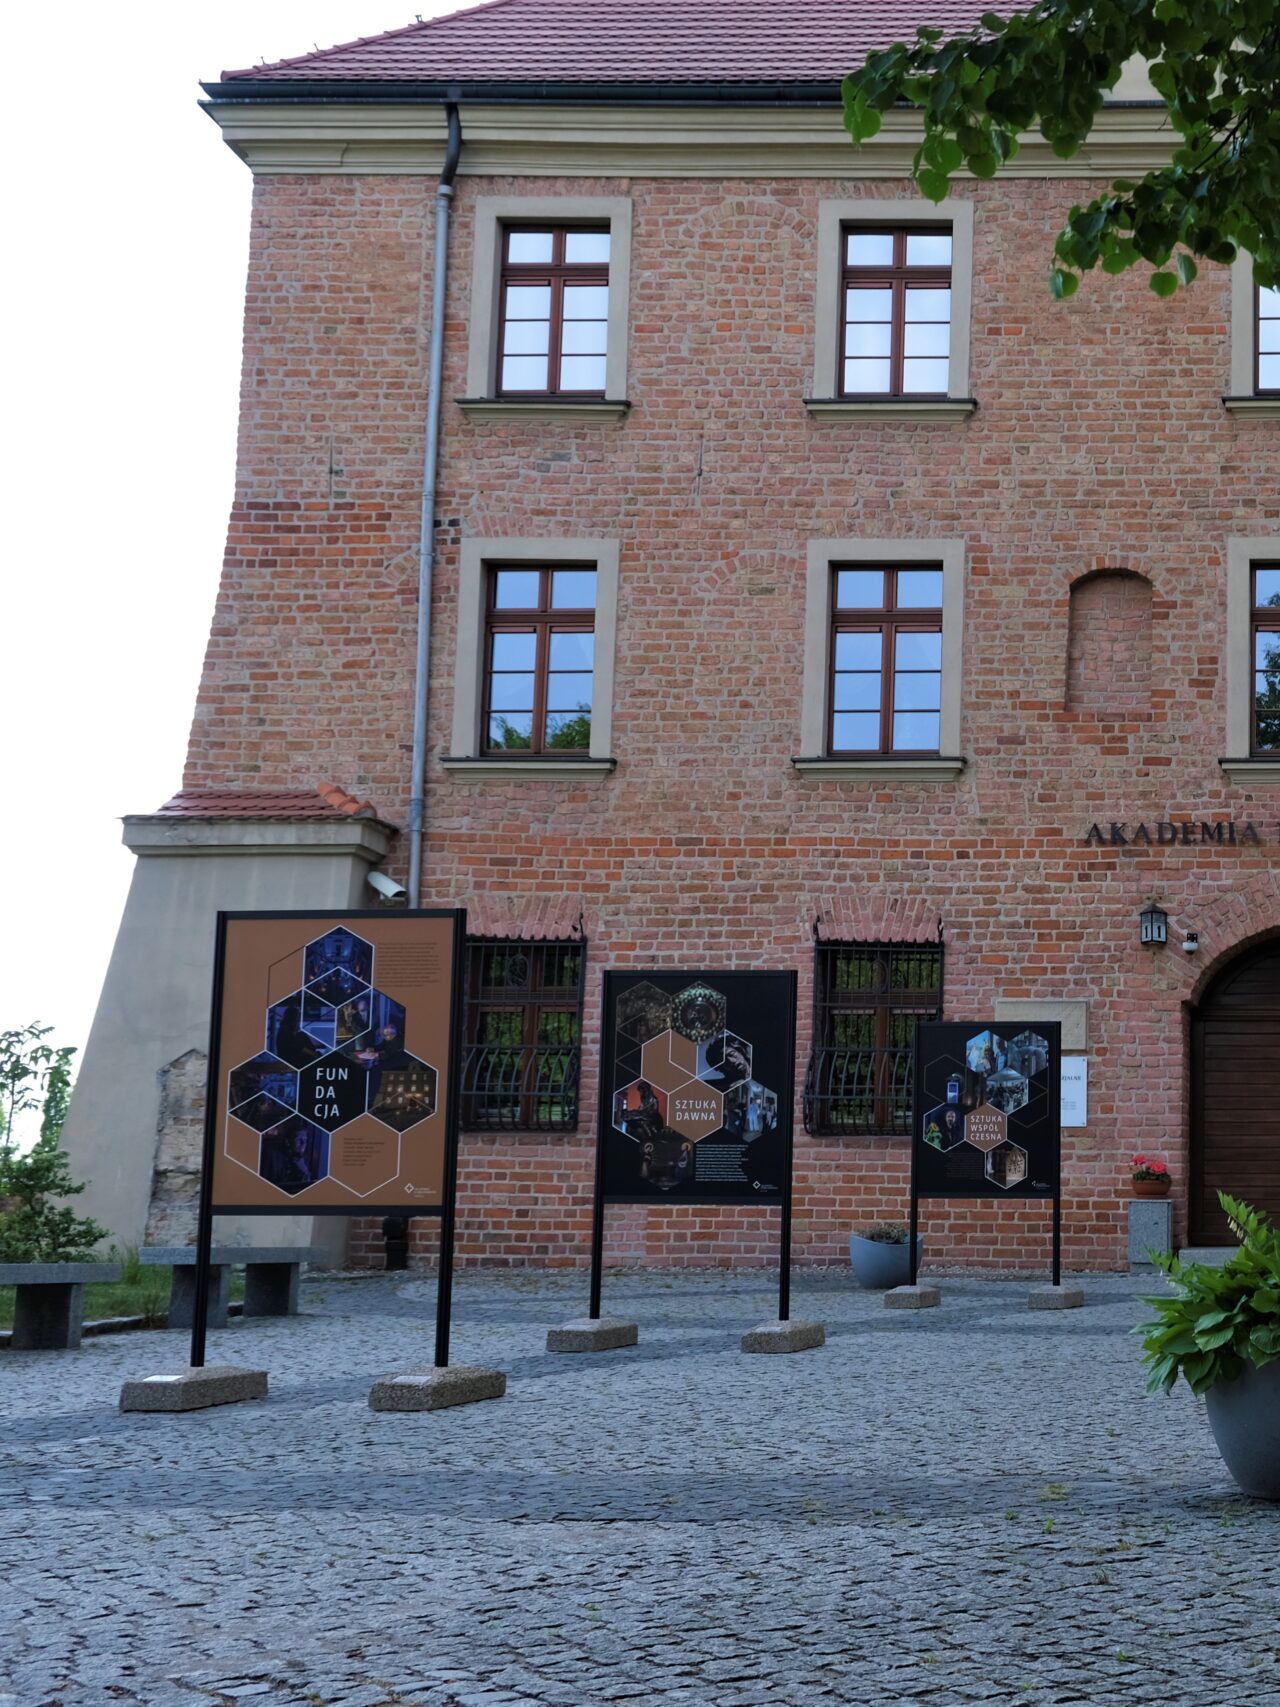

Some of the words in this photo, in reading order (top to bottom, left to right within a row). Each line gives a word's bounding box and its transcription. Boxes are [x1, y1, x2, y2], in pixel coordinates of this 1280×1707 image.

[1085, 821, 1260, 845] AKADEMIA
[316, 1067, 348, 1081] FUN
[315, 1085, 335, 1099] DA
[675, 1100, 717, 1109] SZTUKA
[314, 1103, 340, 1120] CJA
[676, 1111, 716, 1121] DAWNA
[970, 1115, 1002, 1123] SZTUKA
[970, 1133, 1002, 1141] CZESNA
